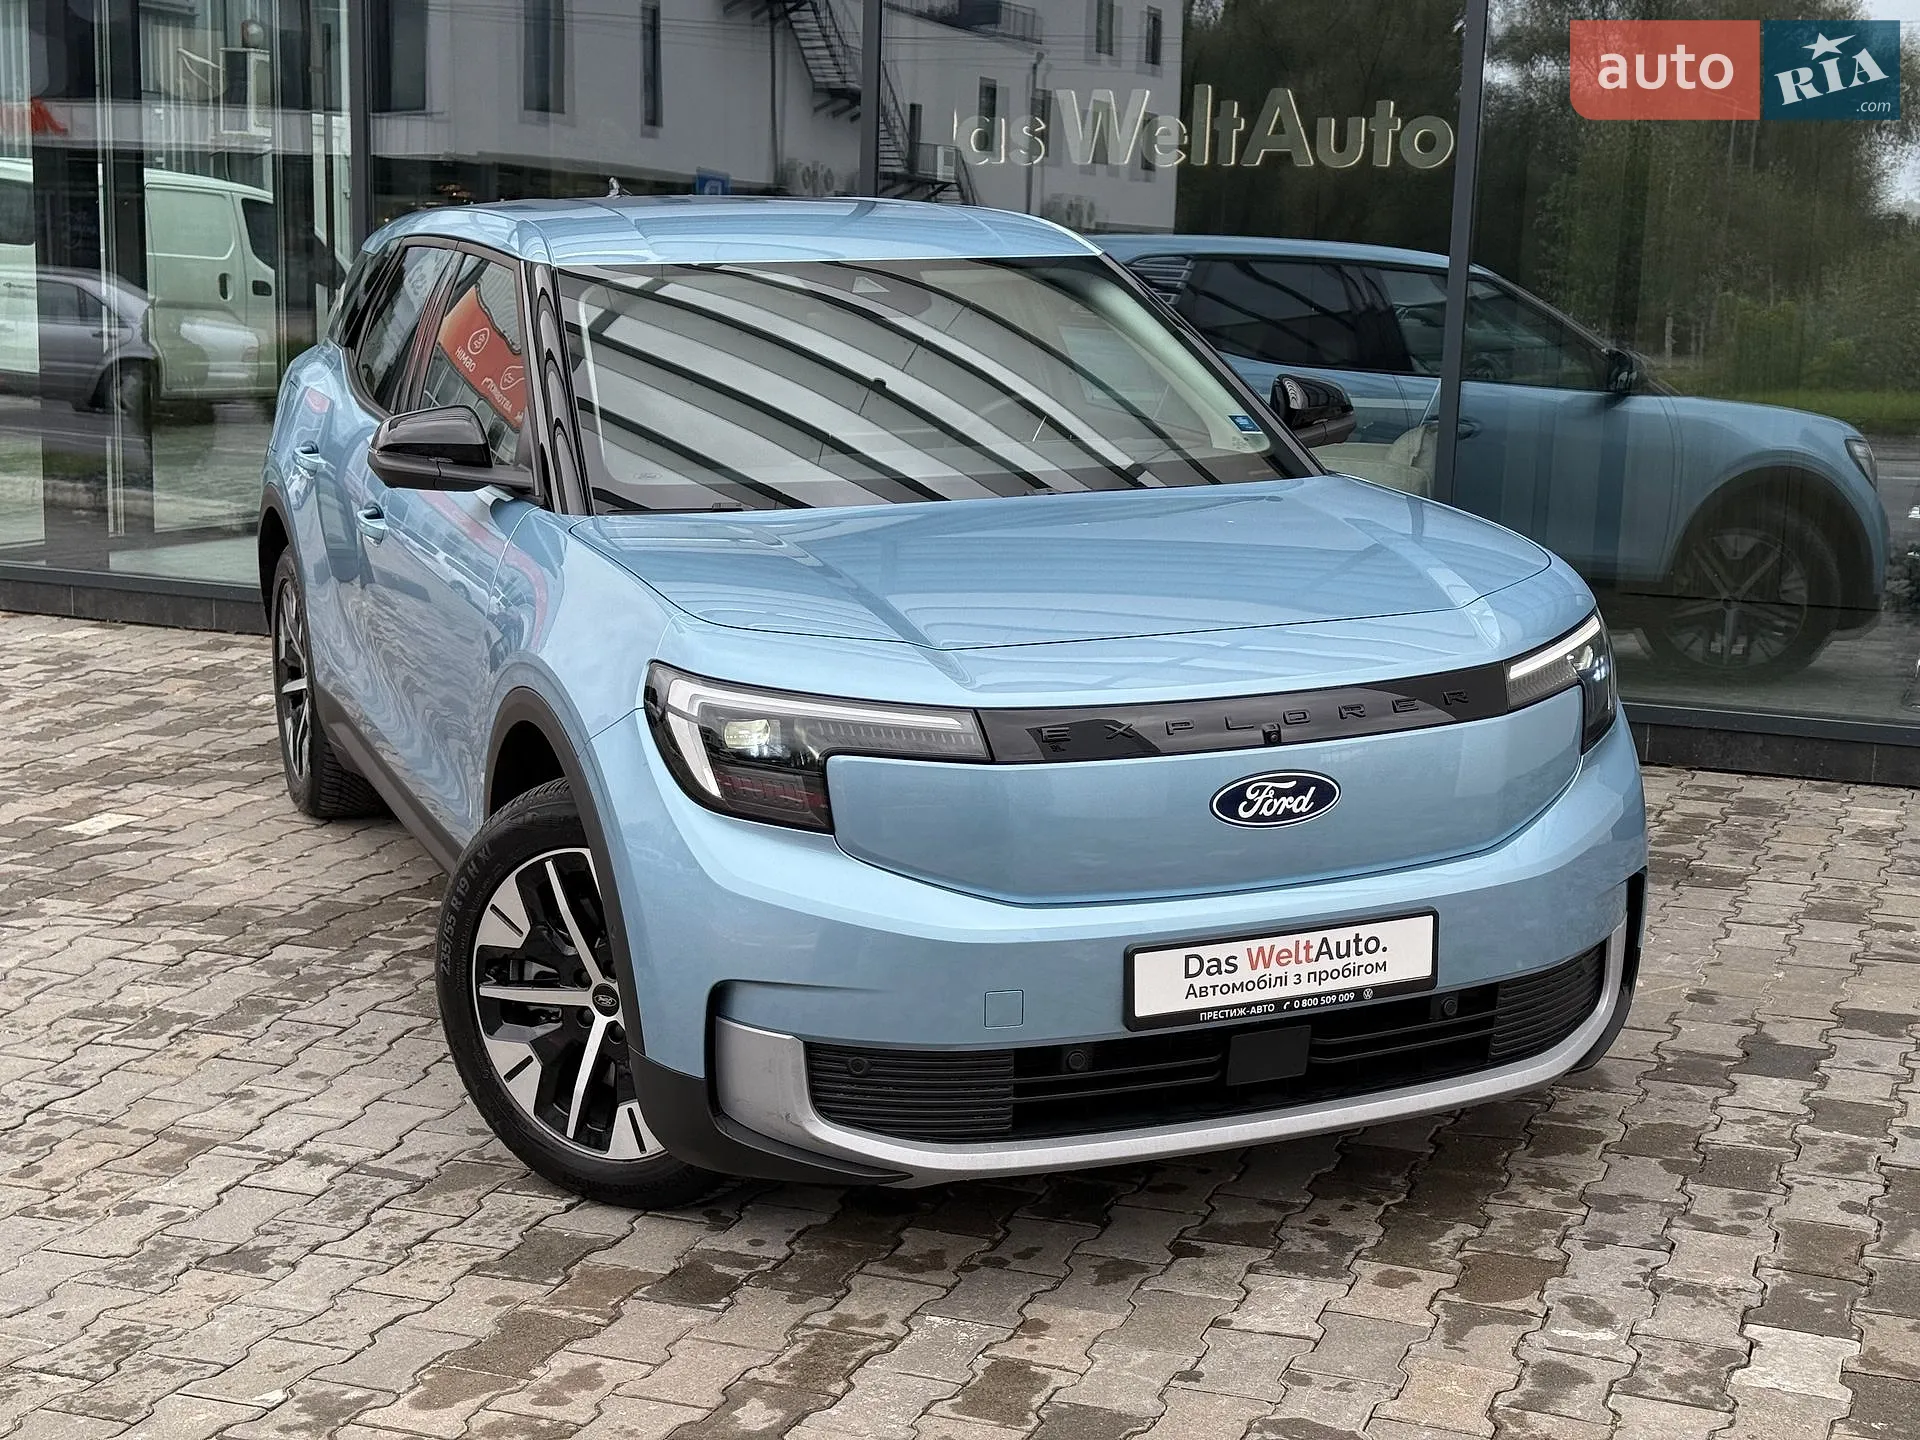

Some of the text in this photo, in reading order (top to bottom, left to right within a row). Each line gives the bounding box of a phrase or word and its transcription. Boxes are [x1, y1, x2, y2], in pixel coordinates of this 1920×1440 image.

[1038, 690, 1470, 743] EXPLORER
[1238, 780, 1316, 819] Ford
[440, 911, 457, 976] 235/55
[450, 895, 463, 912] R
[457, 876, 470, 897] 19
[1184, 933, 1388, 979] Das WeltAuto.
[1185, 961, 1387, 1000] Автомобілі з пробігом
[1199, 1003, 1275, 1021] ПРЕСТИЖ-АВТО
[1301, 997, 1319, 1007] 800
[1320, 994, 1337, 1005] 509
[1338, 992, 1355, 1002] 009
